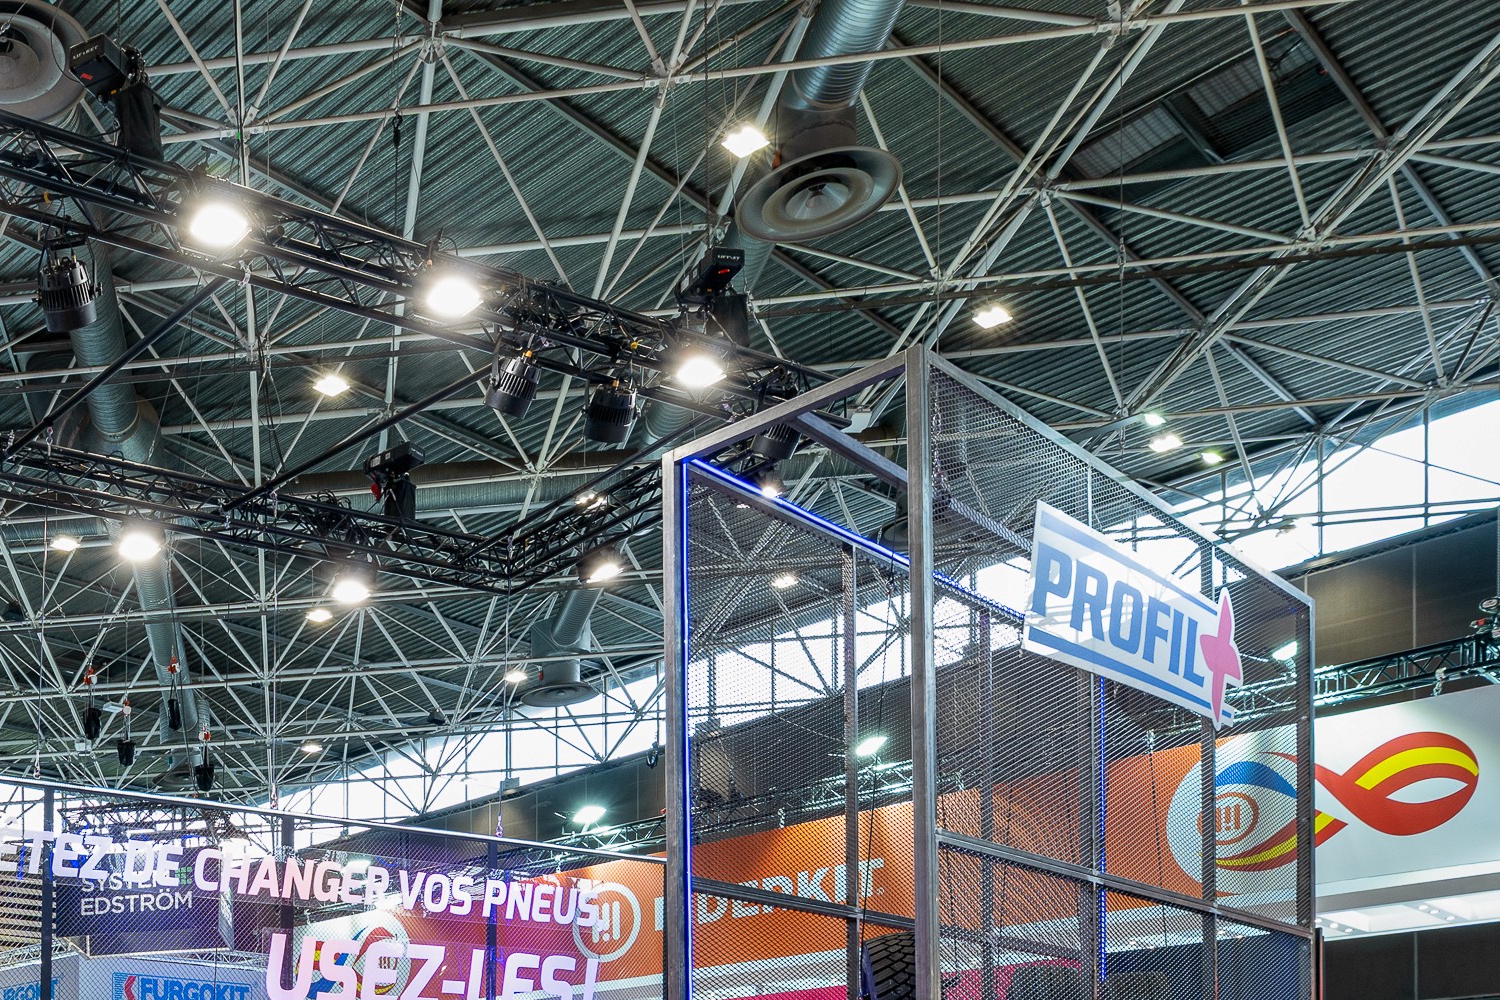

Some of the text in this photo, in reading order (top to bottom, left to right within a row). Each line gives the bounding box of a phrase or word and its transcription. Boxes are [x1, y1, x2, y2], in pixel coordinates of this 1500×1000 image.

[80, 887, 194, 916] EDSTRÖM
[124, 840, 184, 887] DE
[193, 847, 390, 906] CHANGER
[400, 869, 474, 916] VOS
